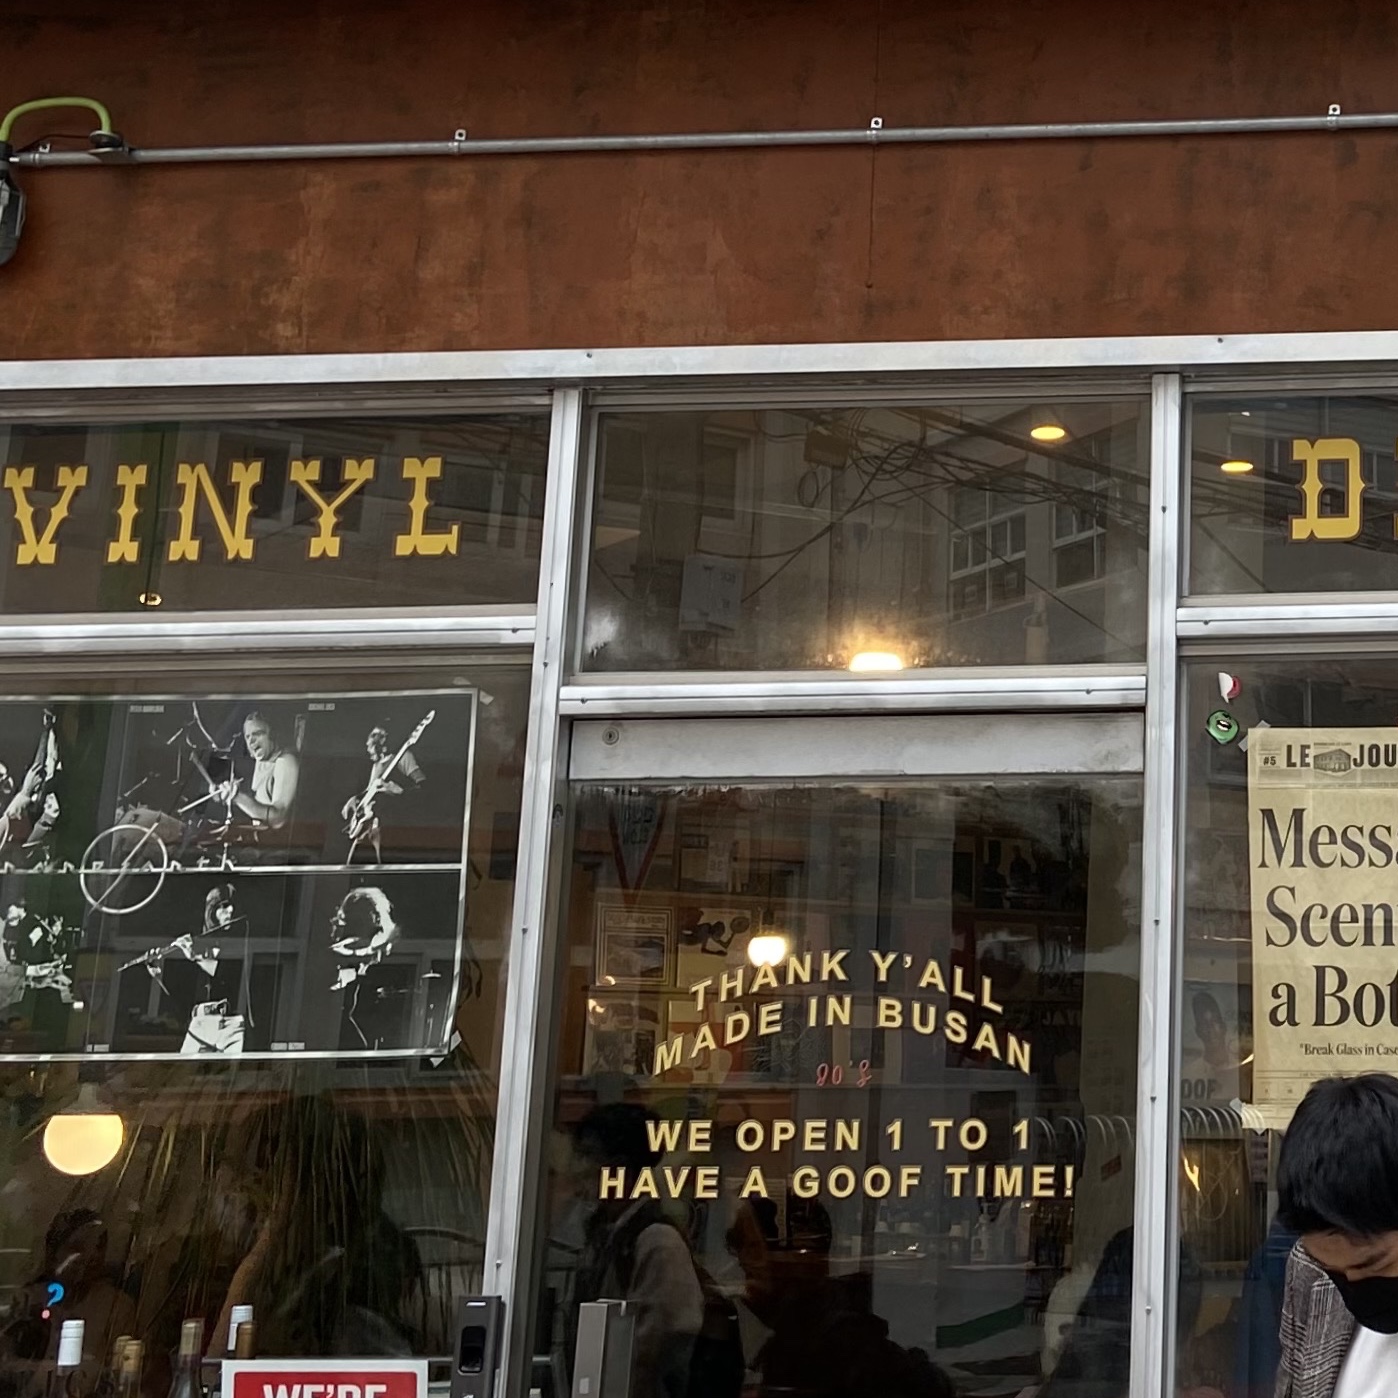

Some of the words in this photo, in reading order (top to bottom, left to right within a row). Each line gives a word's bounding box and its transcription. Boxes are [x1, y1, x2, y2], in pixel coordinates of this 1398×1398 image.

[3, 456, 460, 566] VINYL
[1286, 744, 1311, 768] LE
[687, 948, 852, 1012] THANK
[869, 948, 1005, 1015] Y'ALL
[1268, 982, 1301, 1028] a
[652, 1001, 786, 1078] MADE
[807, 995, 852, 1028] IN
[875, 997, 1033, 1077] BUSAN
[1336, 1042, 1363, 1057] Glass
[1364, 1042, 1375, 1056] in
[645, 1118, 713, 1152] WE
[735, 1117, 861, 1153] OPEN
[885, 1118, 904, 1152] 1
[930, 1117, 989, 1152] TO
[1011, 1117, 1031, 1151] 1
[599, 1165, 720, 1200] HAVE
[740, 1166, 769, 1199] A
[792, 1164, 923, 1200] GOOF
[945, 1163, 1076, 1199] TIME!
